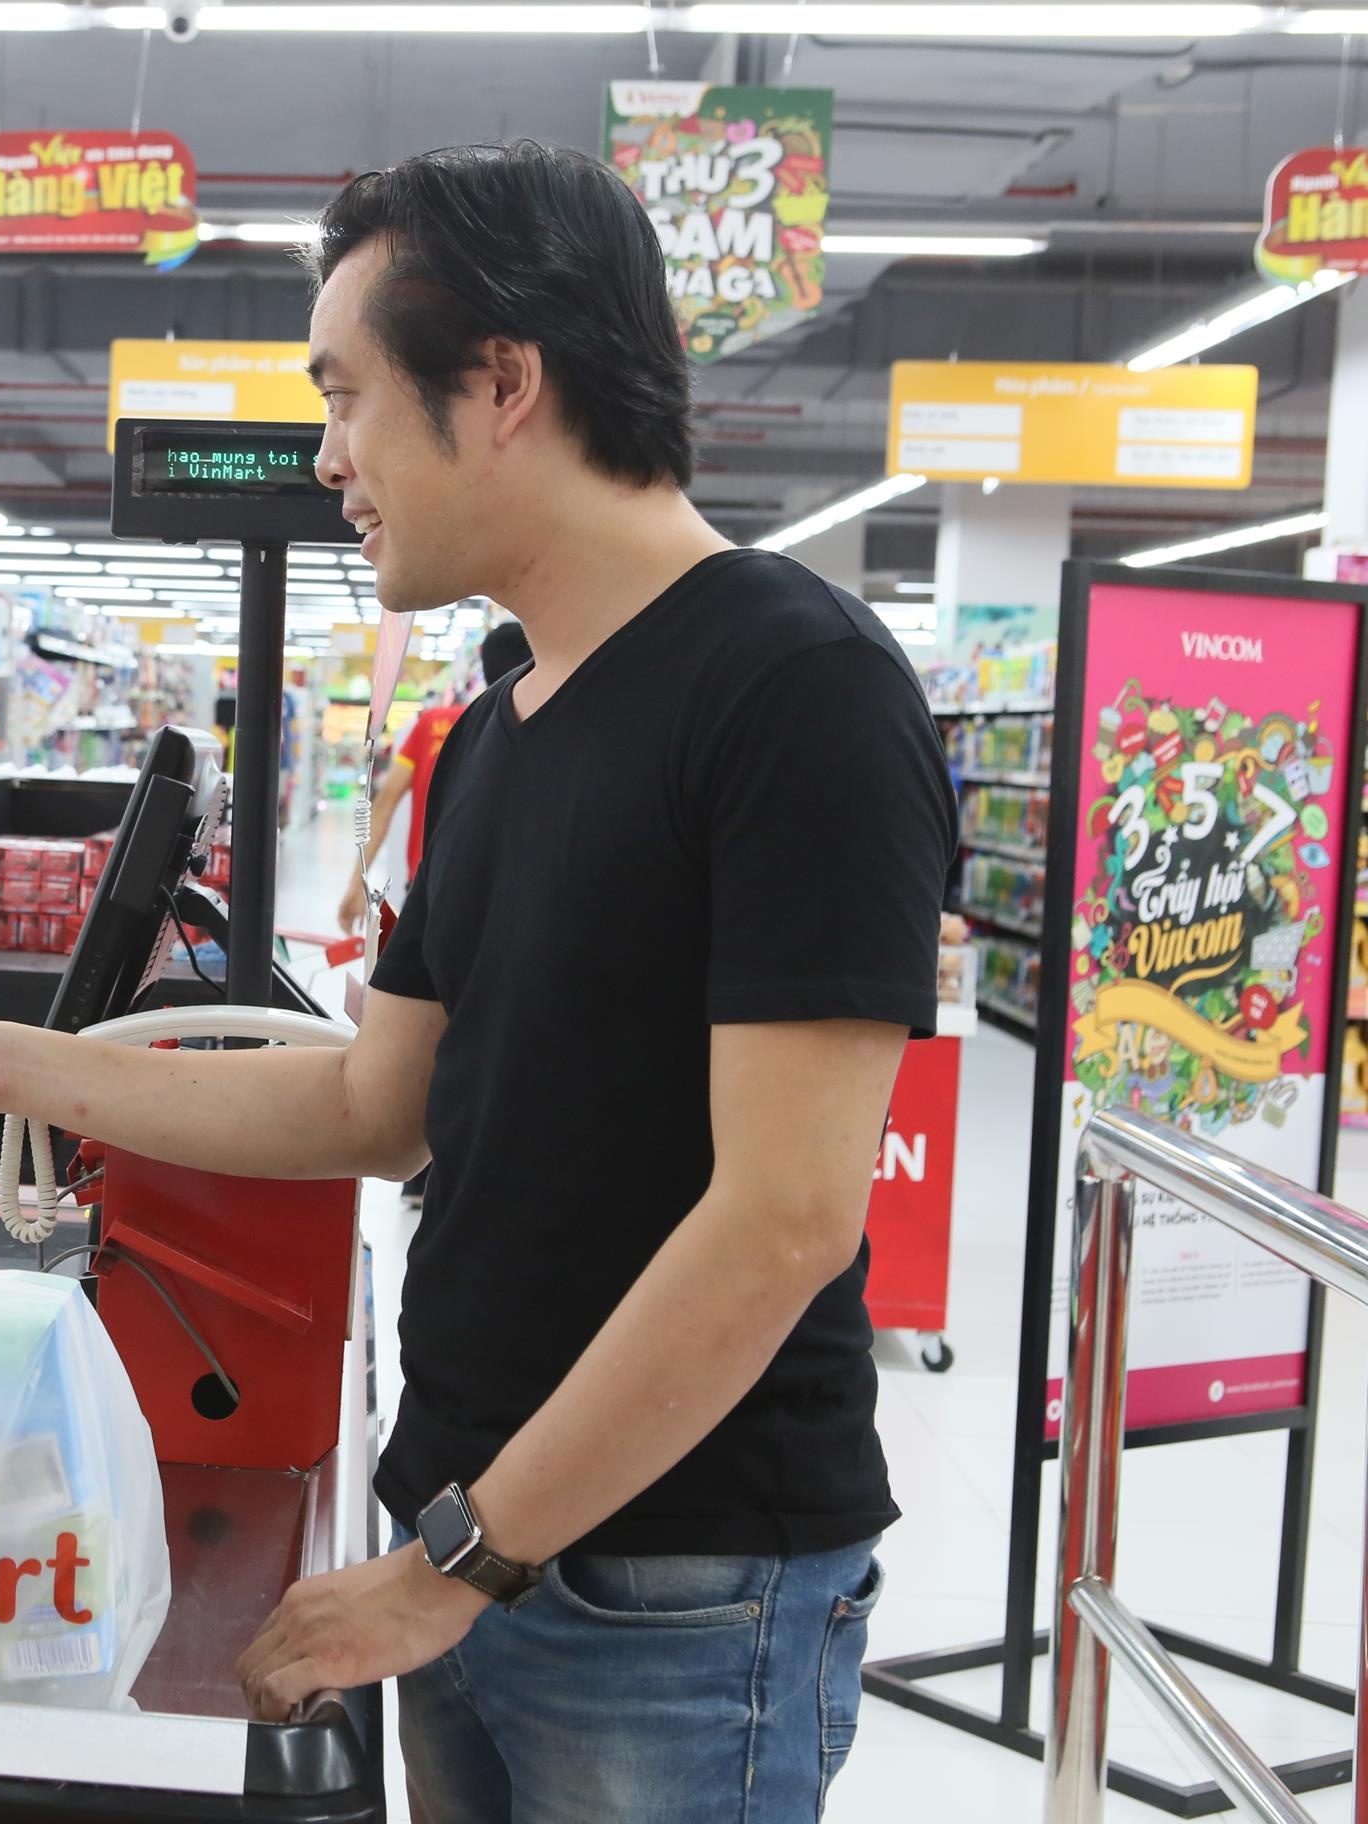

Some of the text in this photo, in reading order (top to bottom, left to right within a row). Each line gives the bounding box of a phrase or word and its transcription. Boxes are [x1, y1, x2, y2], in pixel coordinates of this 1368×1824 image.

[98, 161, 184, 215] Việt
[727, 137, 784, 208] 3
[189, 464, 265, 480] VinMart
[212, 452, 256, 465] mung
[269, 450, 299, 465] toi
[1181, 631, 1263, 663] VINCOM
[1108, 761, 1297, 871] 3 5 7
[1128, 911, 1244, 979] Vincom
